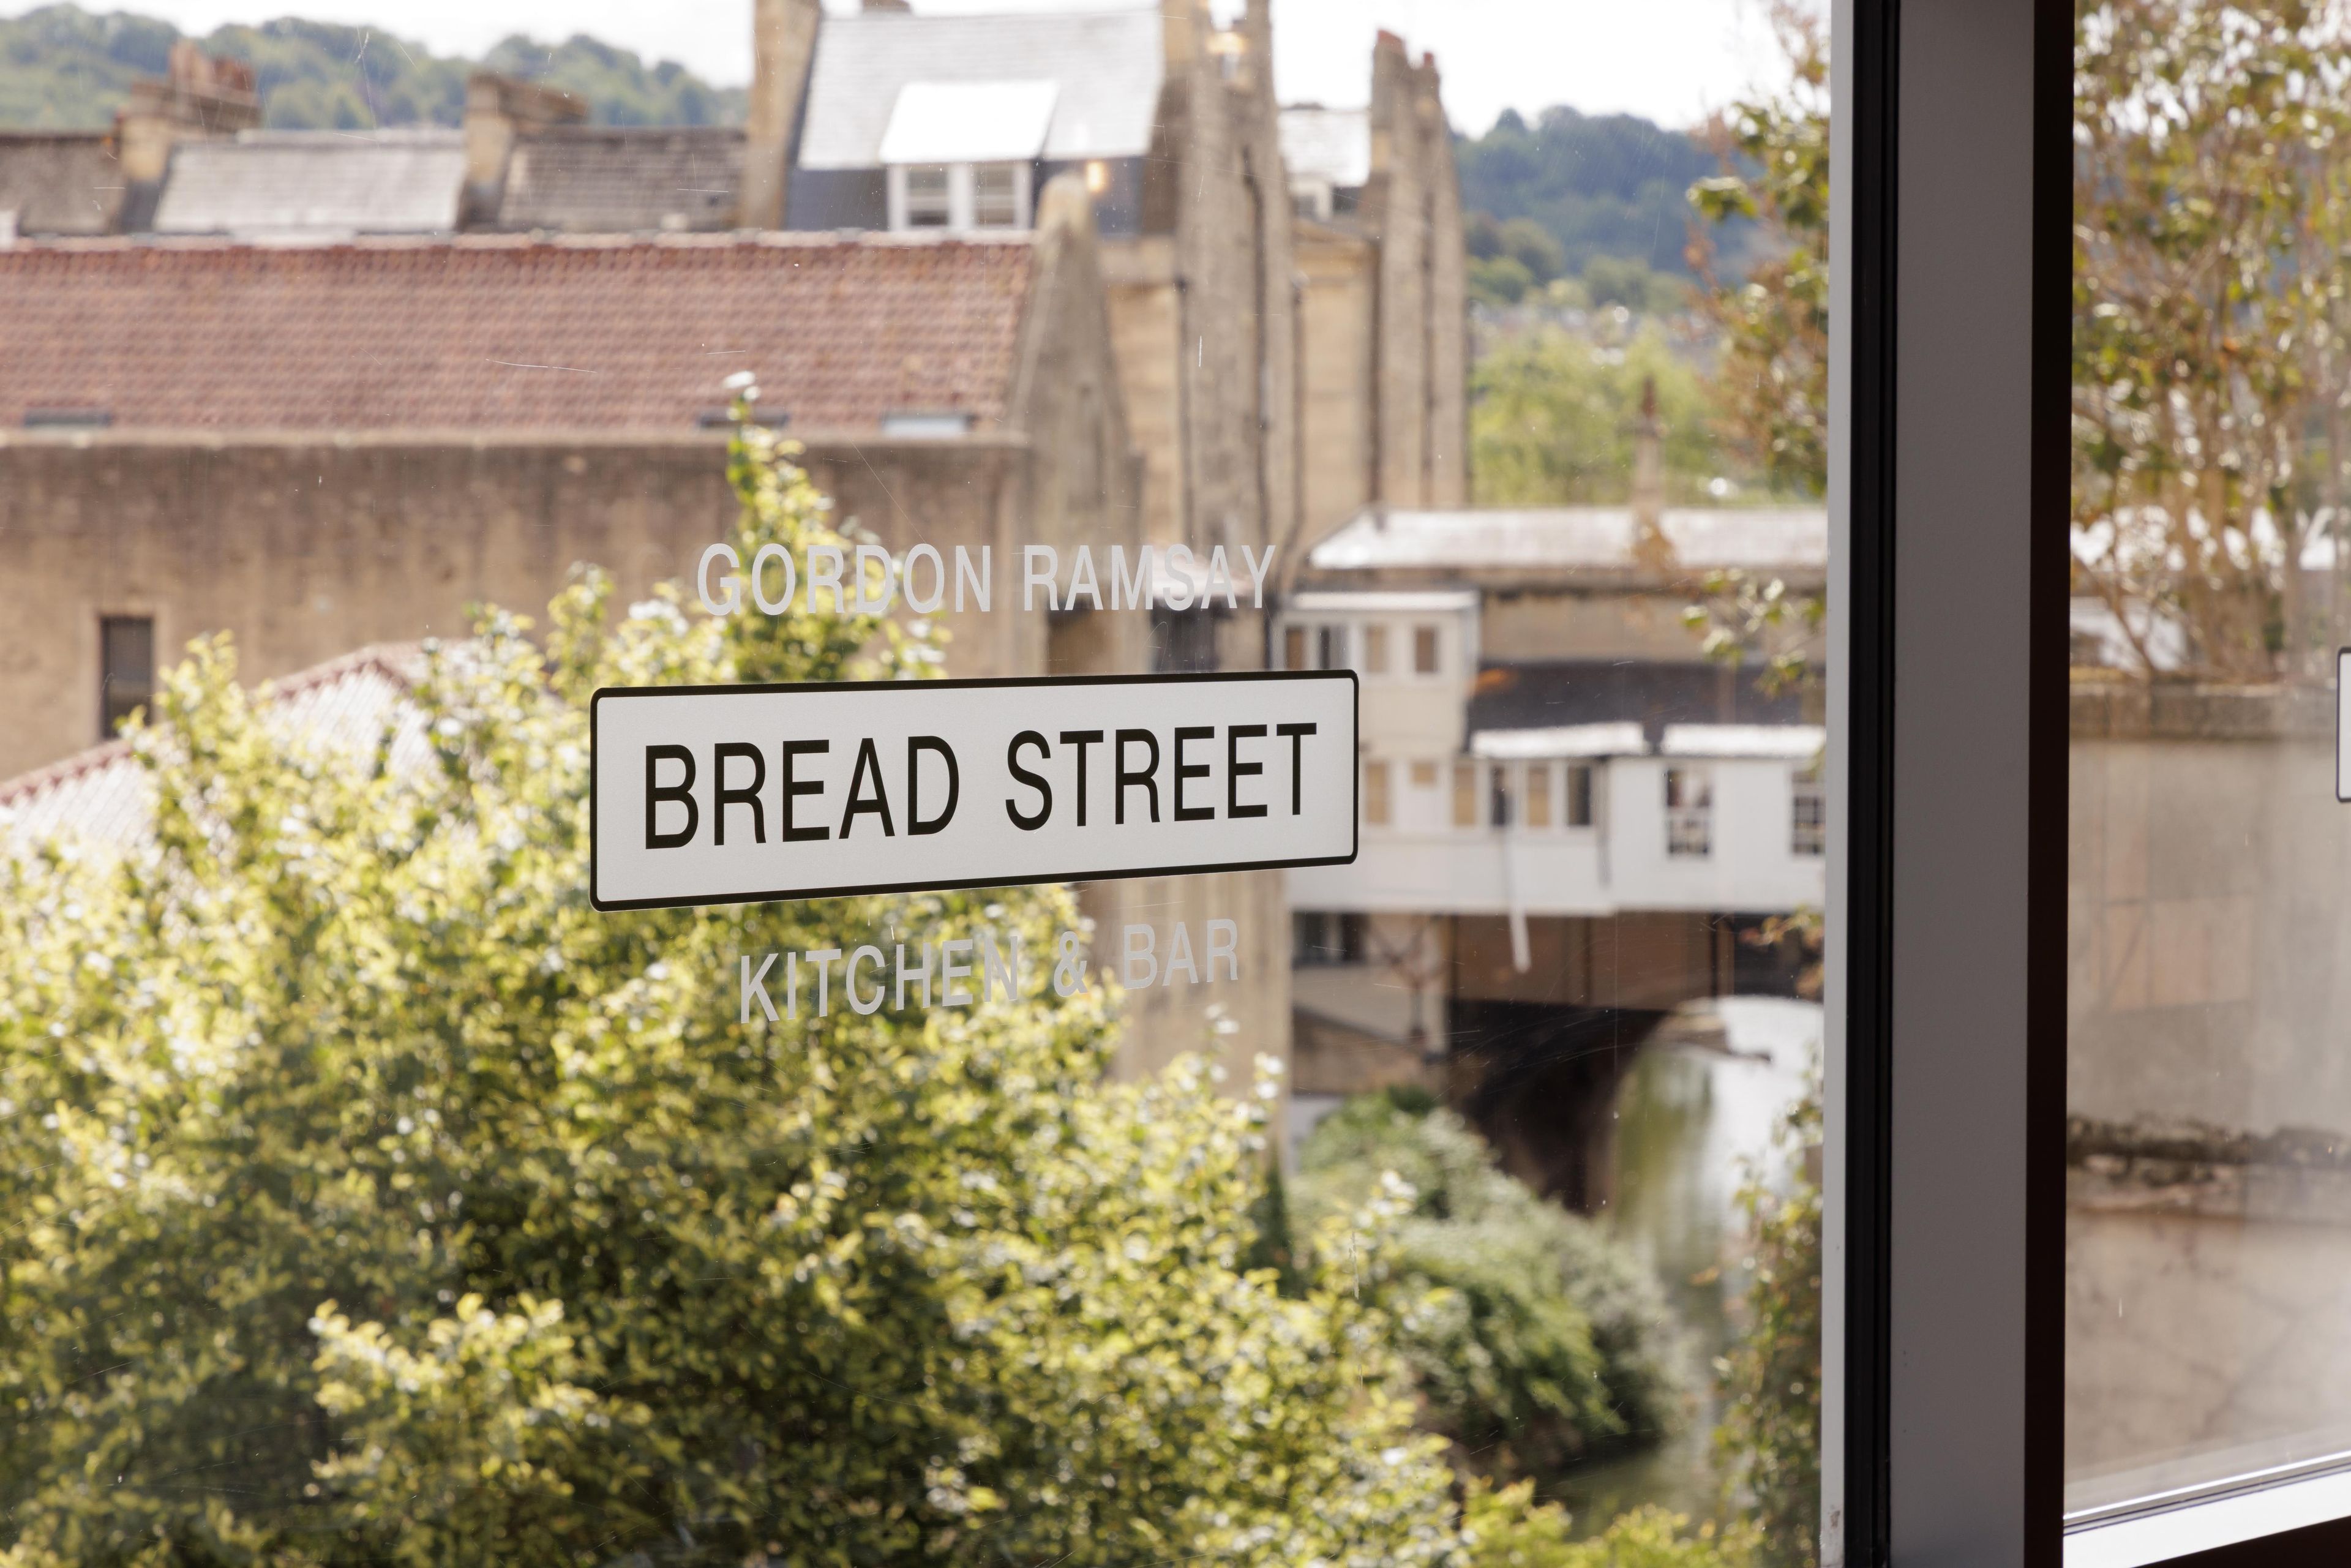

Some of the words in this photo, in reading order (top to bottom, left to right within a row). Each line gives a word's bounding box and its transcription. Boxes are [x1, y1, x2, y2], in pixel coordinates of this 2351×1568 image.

[697, 542, 991, 615] GORDON
[1024, 542, 1277, 612] RAMSAY
[645, 735, 960, 850] BREAD
[1005, 722, 1318, 831] STREET
[740, 935, 1019, 1024] KITCHEN
[1053, 930, 1089, 998] &
[1123, 918, 1240, 991] BAR
